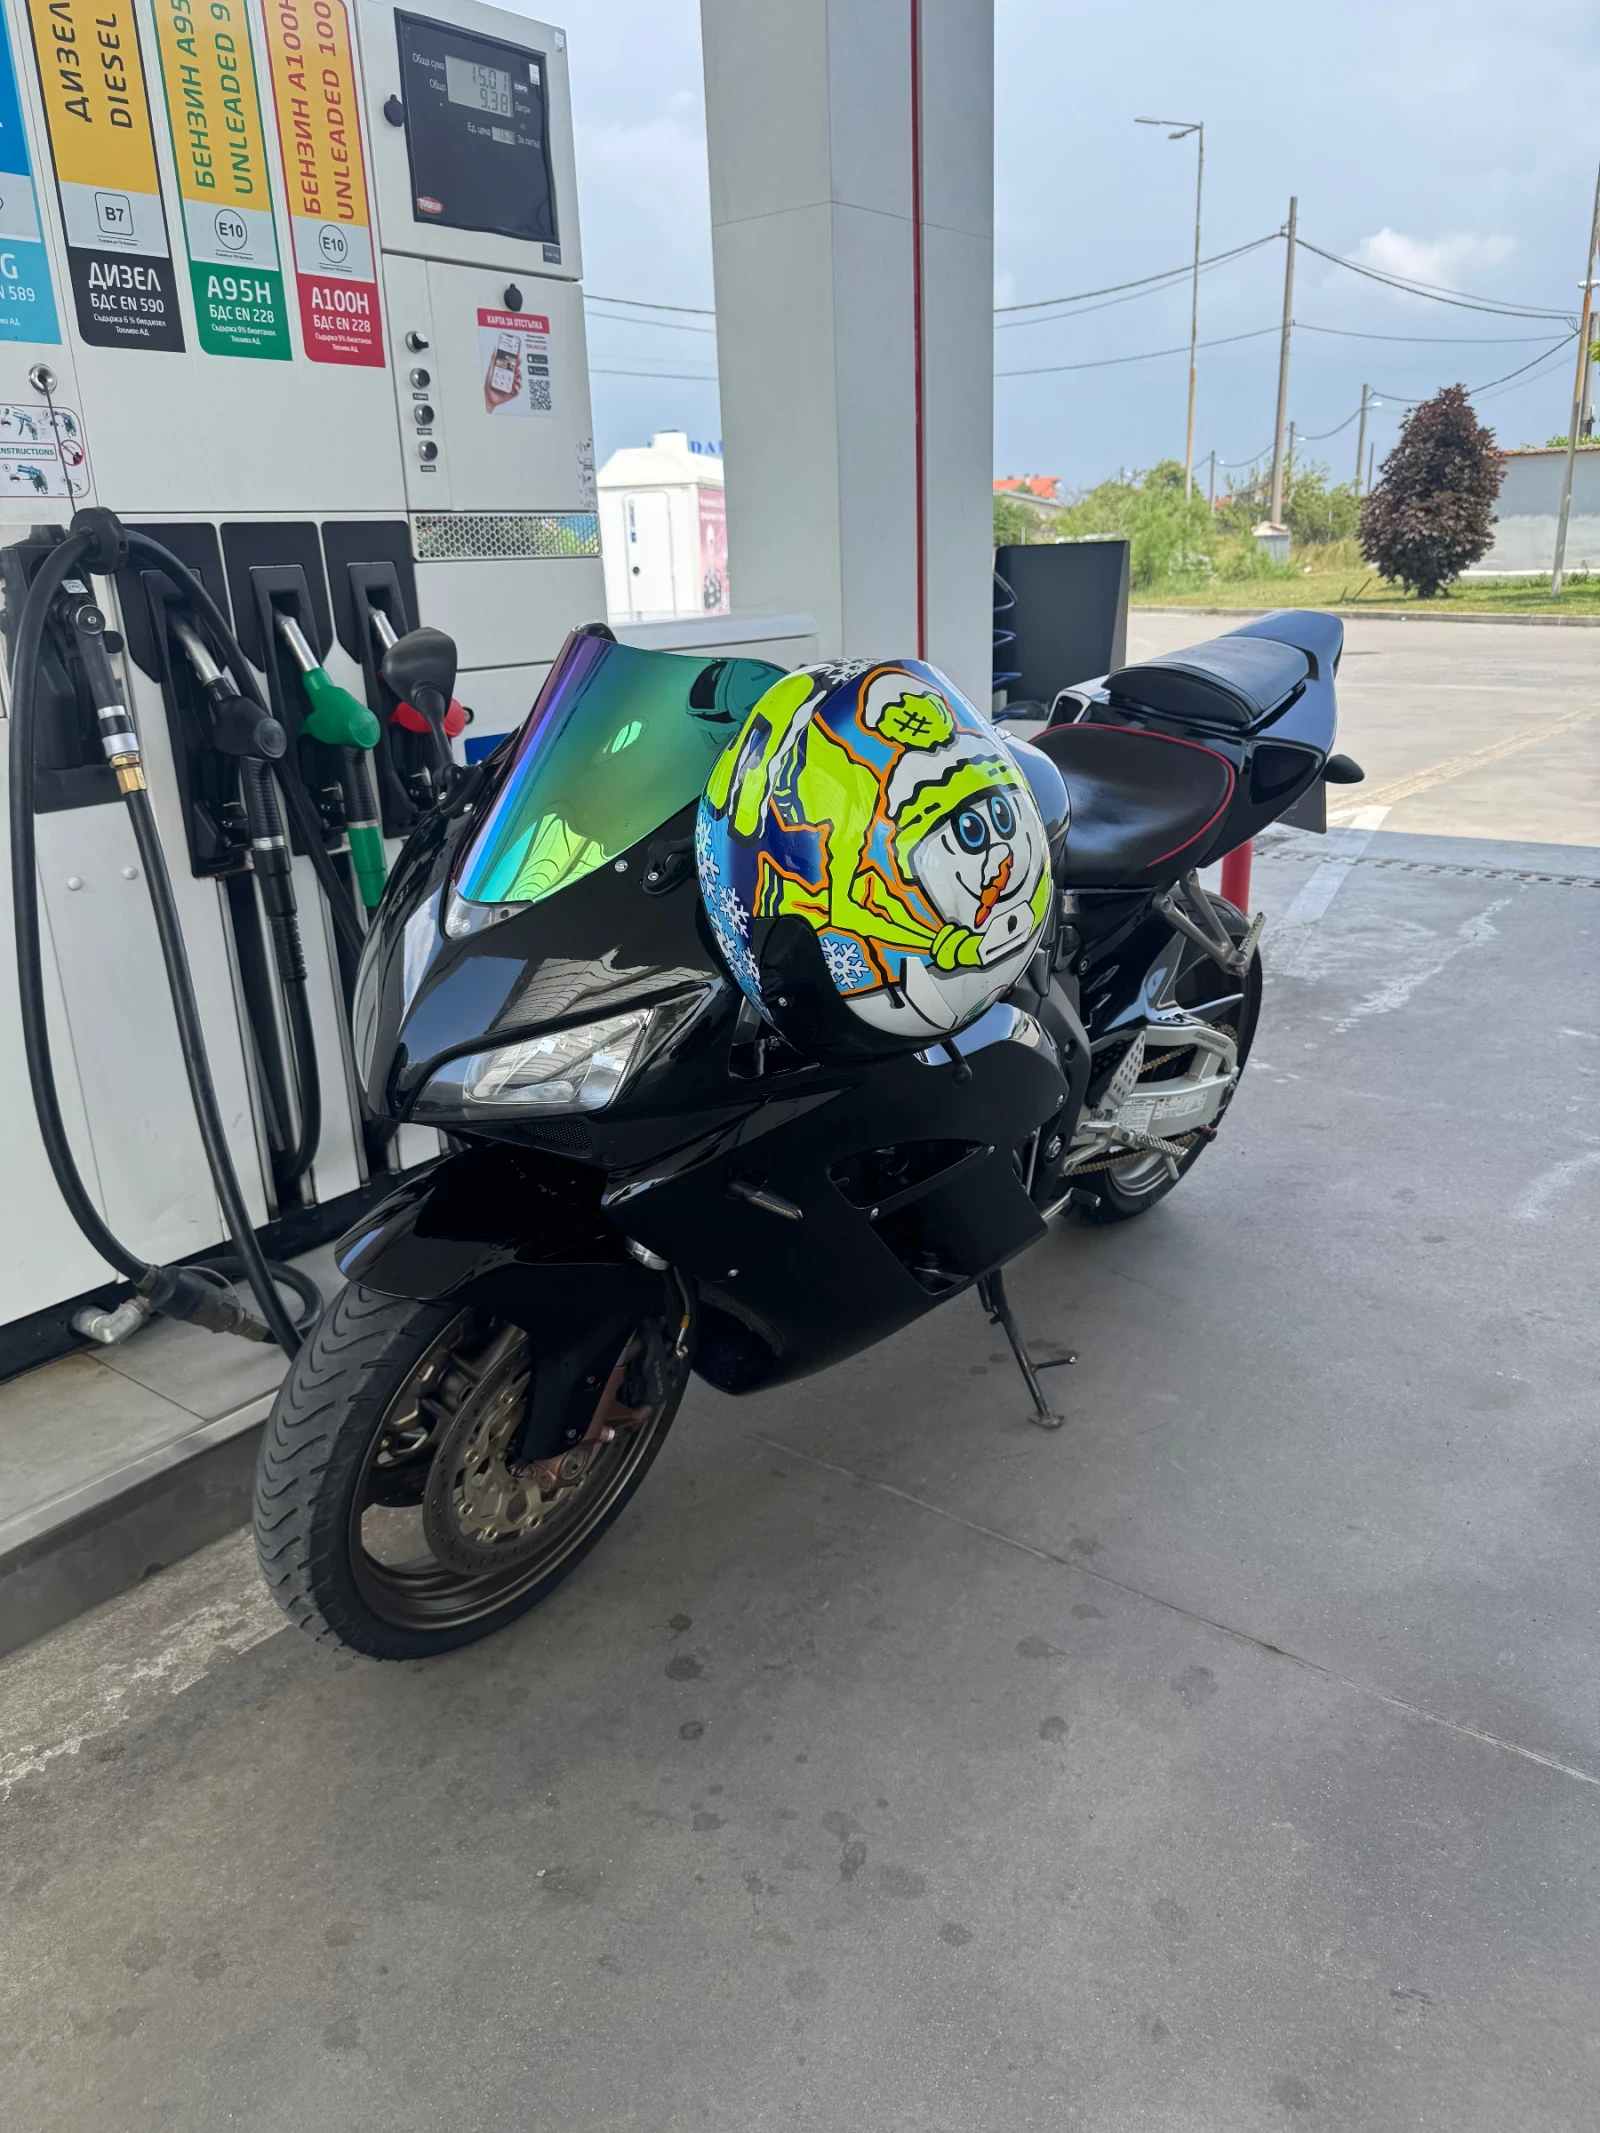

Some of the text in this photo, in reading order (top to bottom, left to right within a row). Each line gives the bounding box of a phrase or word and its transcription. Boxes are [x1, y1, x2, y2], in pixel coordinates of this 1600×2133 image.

[49, 2, 93, 123] ДИЗЕЛ
[96, 13, 132, 128] DIESEL
[210, 0, 254, 195] UNLEADED 9
[313, 1, 355, 220] UNLEADED 100
[180, 64, 216, 189] БЕНЗИН
[291, 98, 322, 215] БЕНЗИН
[105, 206, 124, 222] B7
[218, 222, 244, 238] E10
[322, 237, 344, 252] E10
[88, 261, 162, 292] ДИЗЕЛ
[8, 285, 36, 302] 589
[90, 292, 164, 313] БДС EN 590
[93, 313, 123, 324] Съдържа
[209, 304, 275, 324] БДС EN 228
[313, 314, 371, 333] БДС EN 228
[0, 447, 54, 456] NSTRUCTIONS
